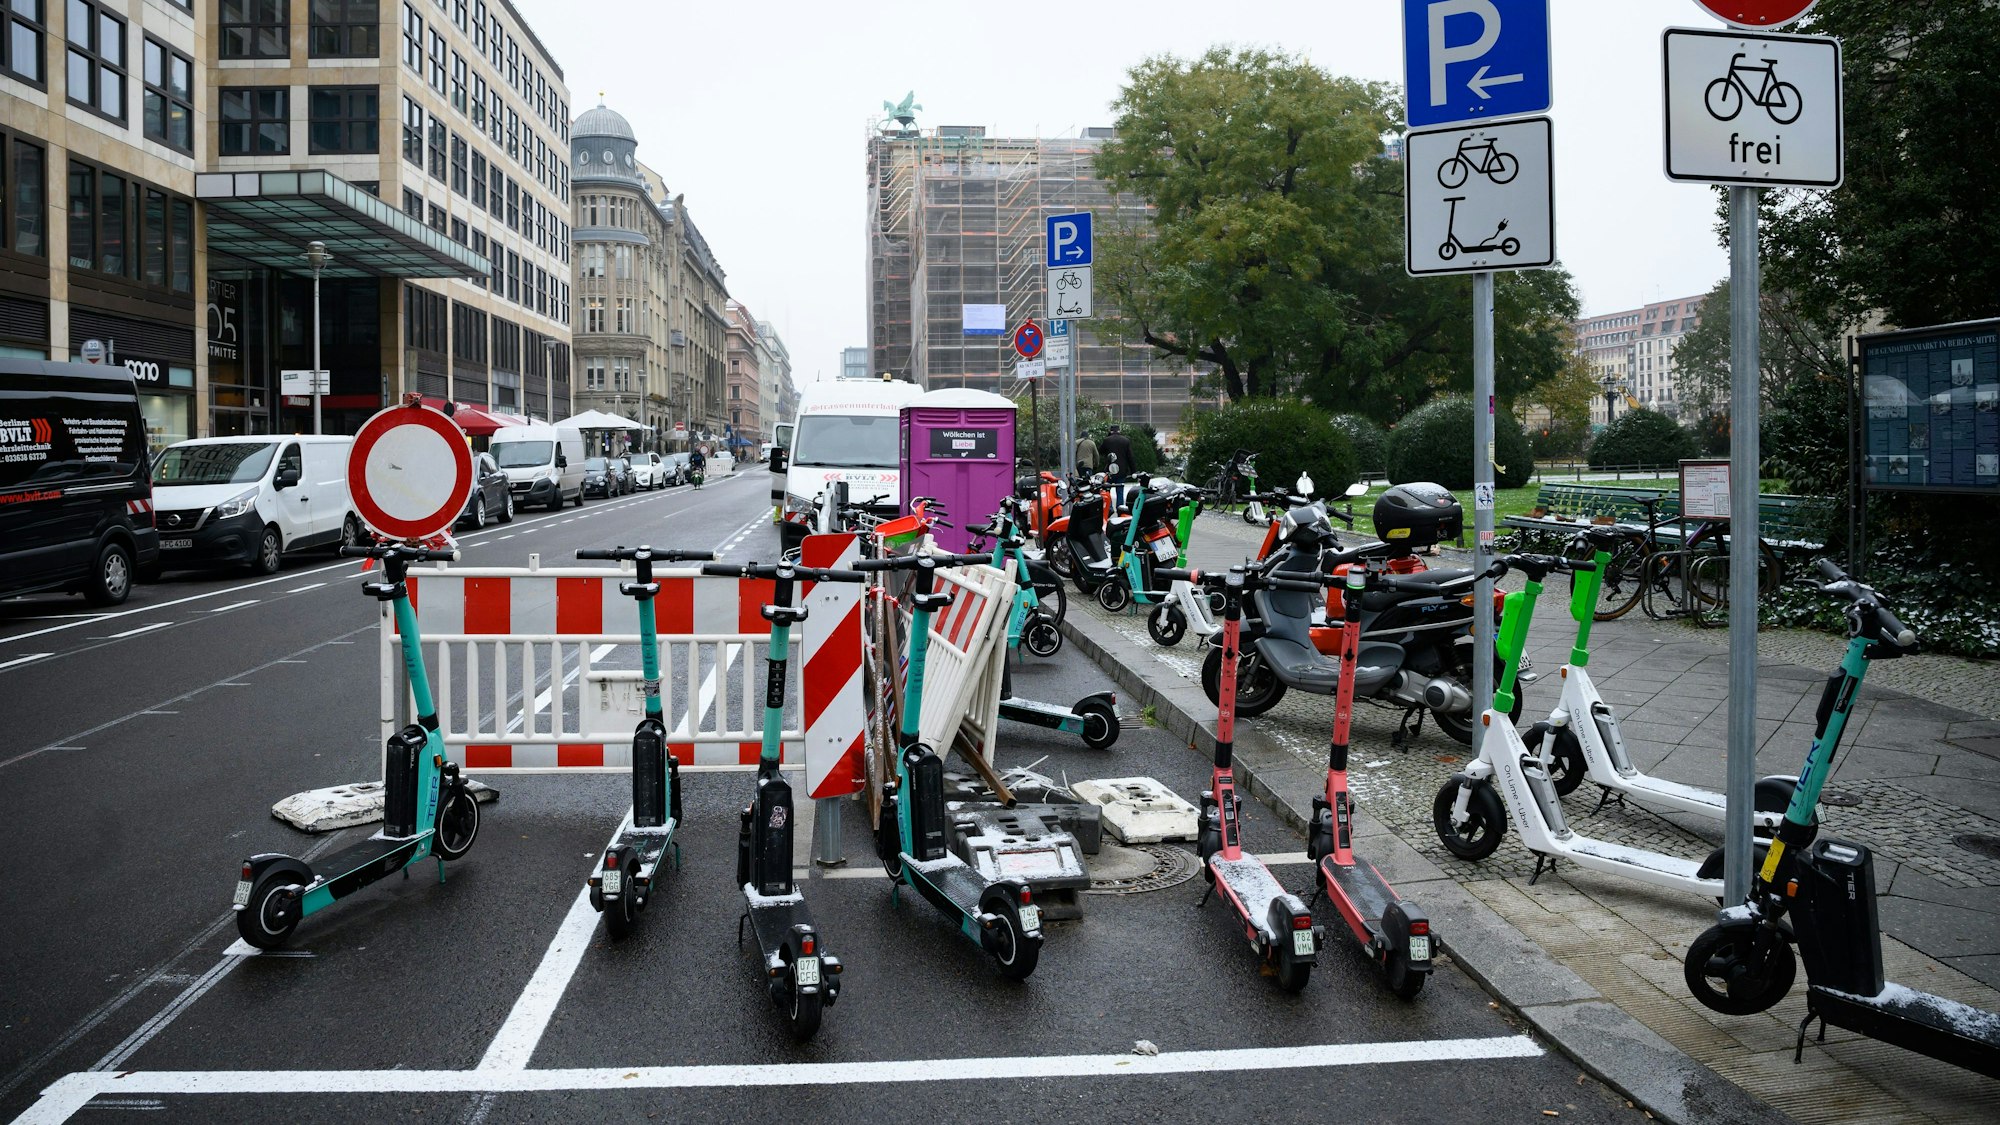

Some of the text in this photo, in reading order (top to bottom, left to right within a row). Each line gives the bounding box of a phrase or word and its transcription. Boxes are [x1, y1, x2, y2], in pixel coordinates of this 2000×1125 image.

[1428, 1, 1502, 107] P
[1729, 133, 1781, 165] frei
[1053, 221, 1078, 261] P
[1880, 341, 1938, 354] GENDARMENMARKT
[1939, 339, 1947, 348] IN
[1947, 335, 1998, 347] BERLIN-MITTE
[0, 427, 32, 444] BVLT
[1421, 604, 1440, 613] FLY
[1015, 611, 1026, 633] TIER
[1576, 719, 1587, 740] Lime
[1585, 745, 1595, 764] Uber
[427, 776, 439, 822] TIER
[1504, 764, 1511, 777] On
[1508, 778, 1519, 801] Lime
[1518, 806, 1530, 830] Uber
[604, 872, 619, 881] 685
[1846, 871, 1856, 900] TIER
[1295, 932, 1311, 942] 782
[1296, 943, 1312, 953] YMW
[800, 959, 816, 971] 077
[800, 971, 817, 983] CFG
